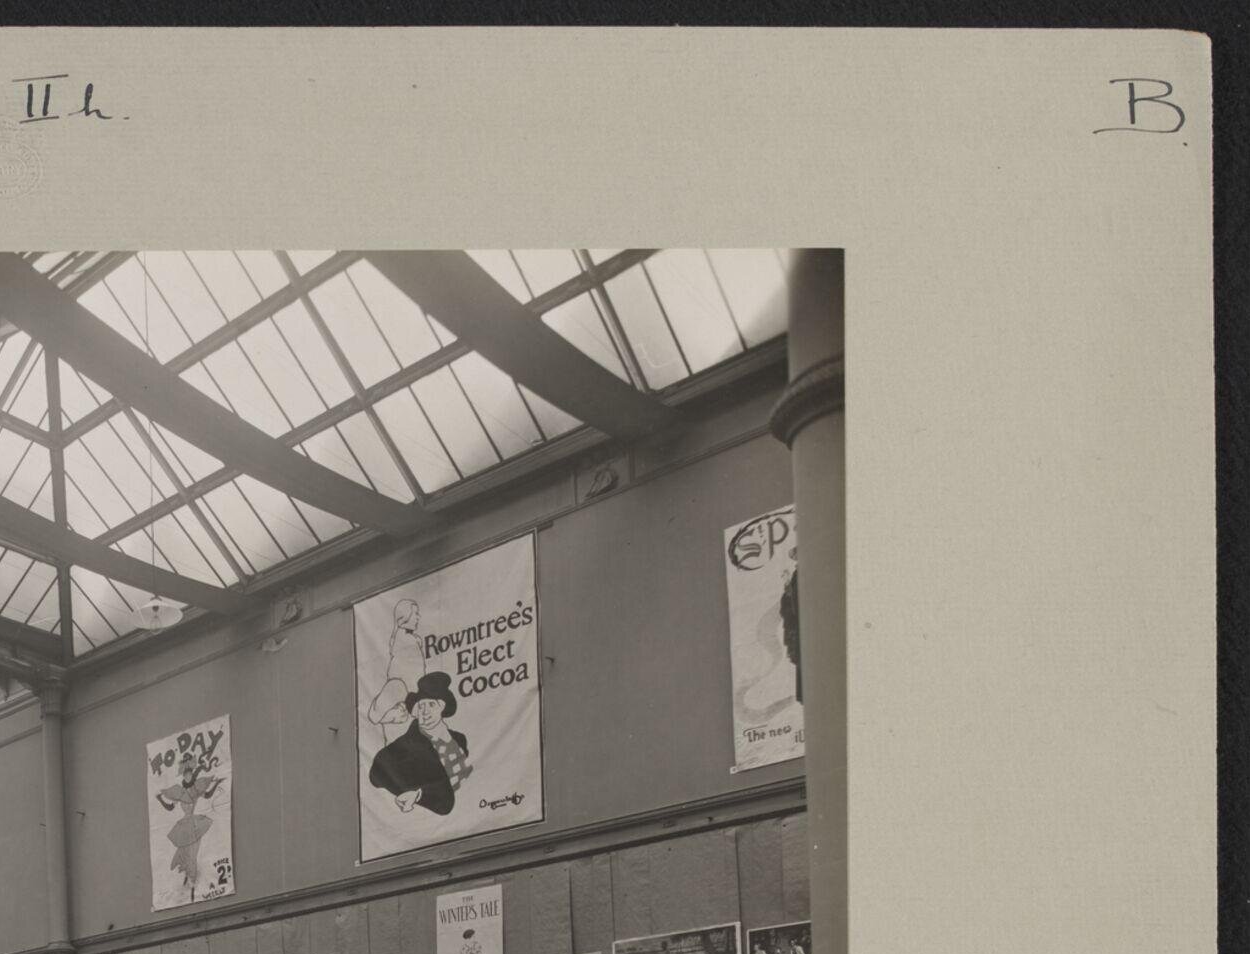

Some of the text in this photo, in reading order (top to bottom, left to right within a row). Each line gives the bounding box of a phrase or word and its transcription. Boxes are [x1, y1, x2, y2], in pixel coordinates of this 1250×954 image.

[424, 600, 533, 659] Rowntree's
[456, 640, 515, 675] Elect
[458, 663, 529, 697] Cocoa
[479, 899, 500, 919] TALE
